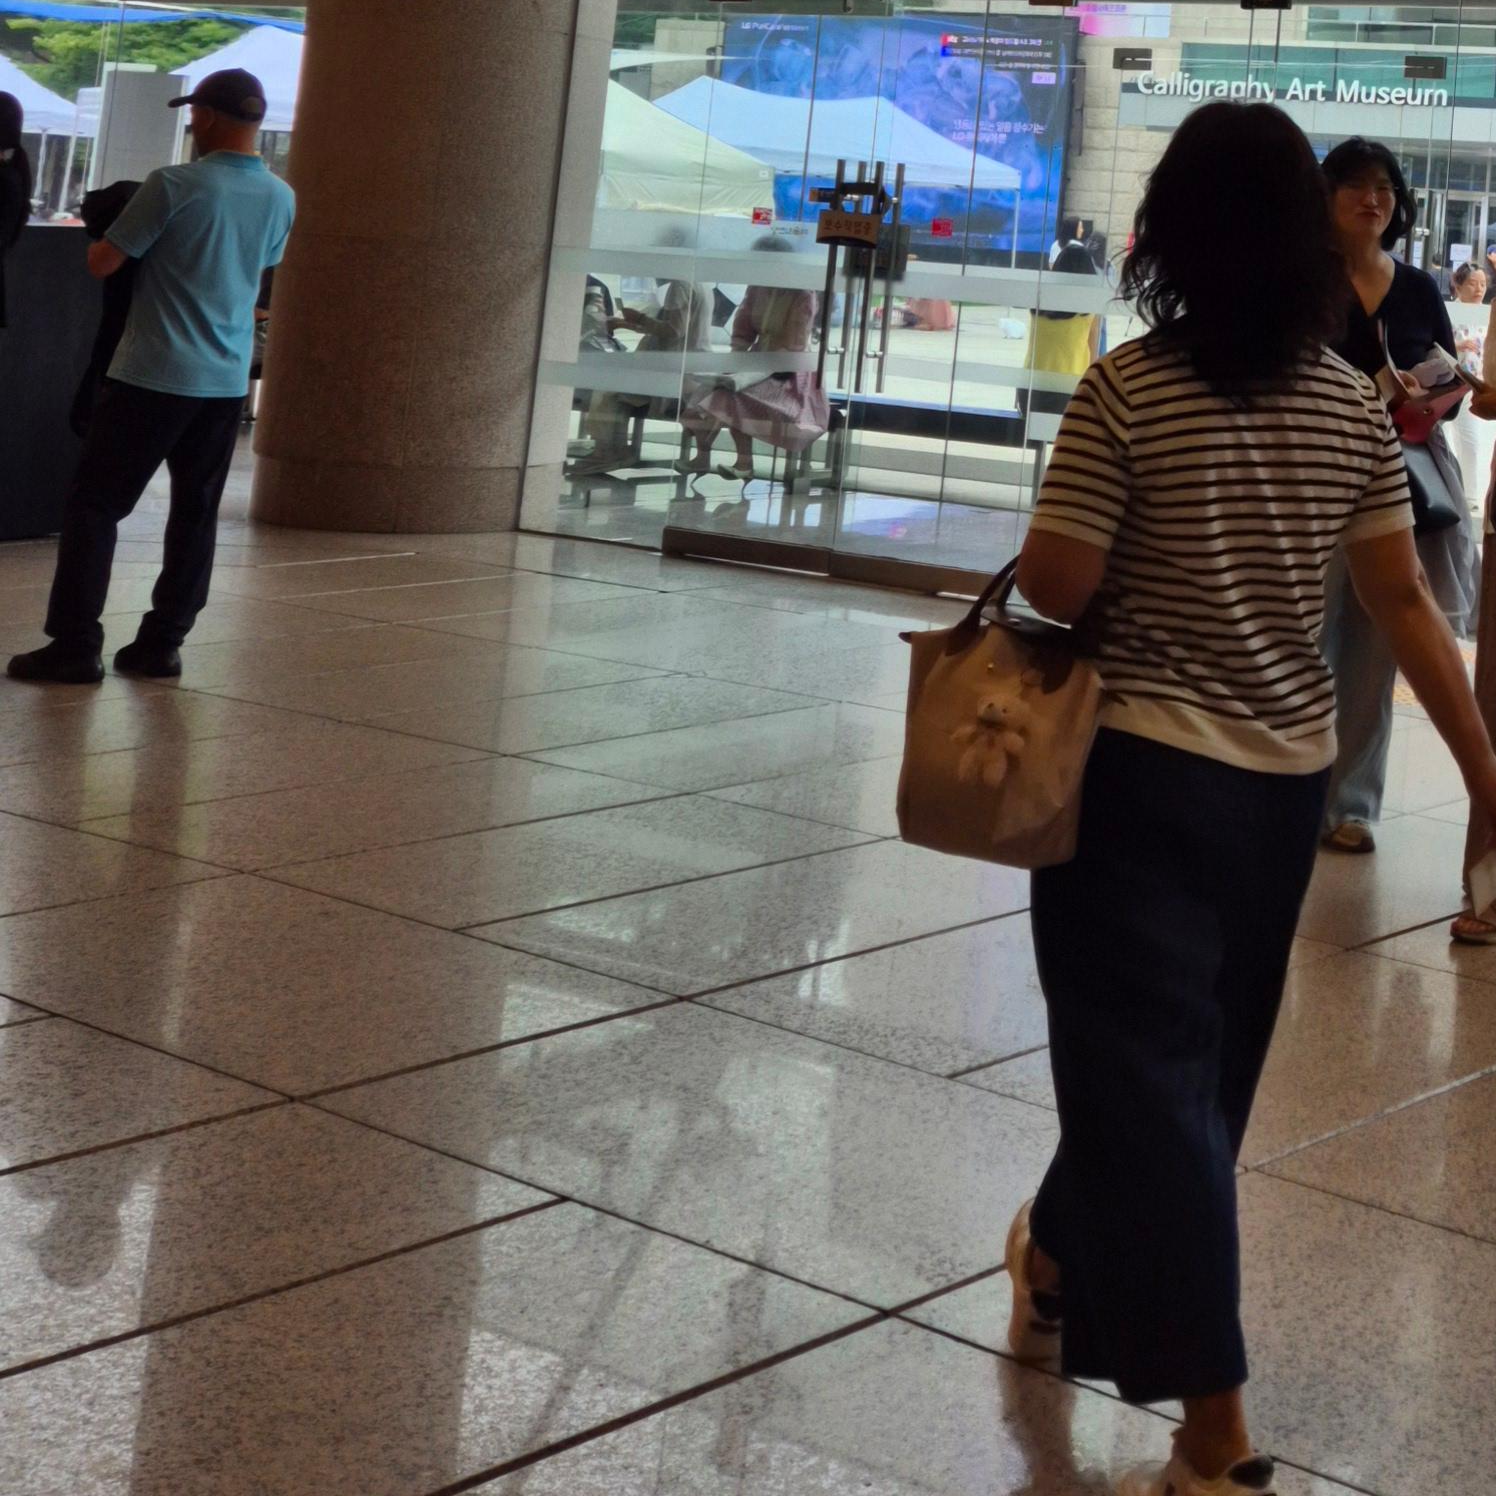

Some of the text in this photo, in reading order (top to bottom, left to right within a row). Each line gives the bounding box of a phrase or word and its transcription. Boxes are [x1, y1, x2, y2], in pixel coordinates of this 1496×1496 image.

[1137, 70, 1448, 107] Calligraphy Art Museum
